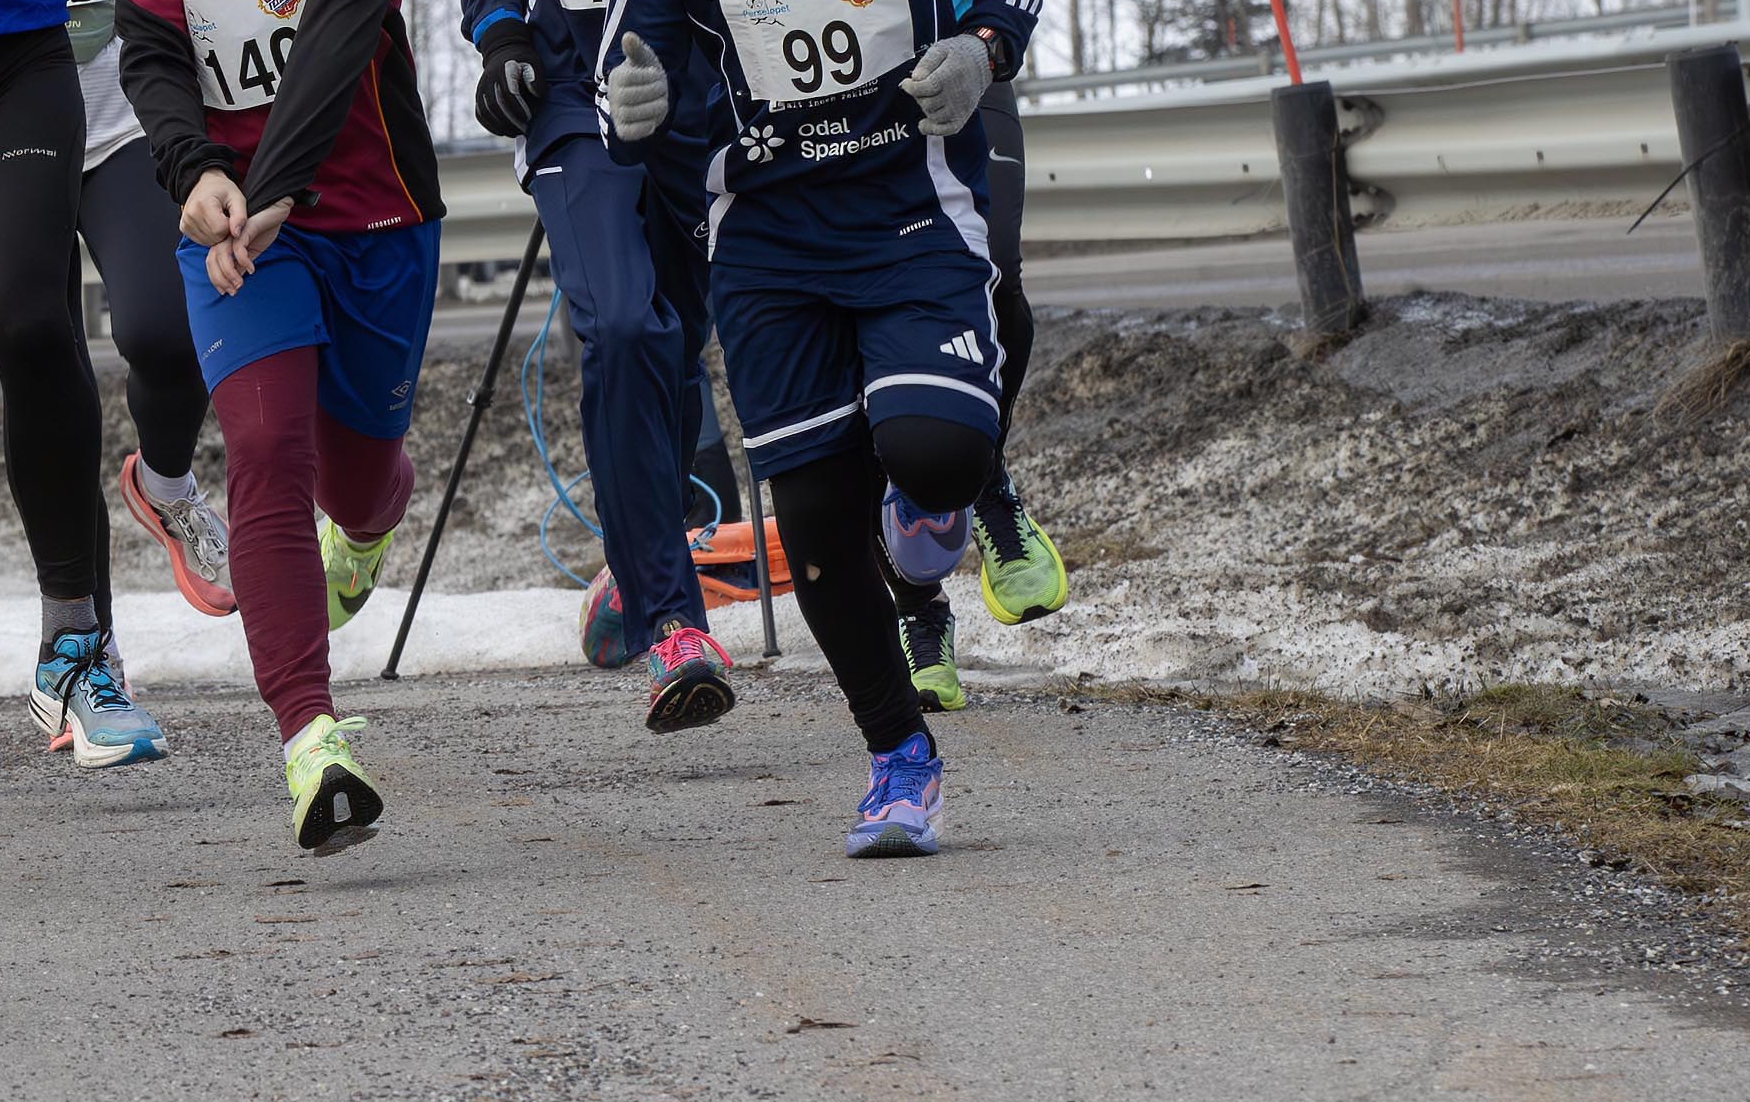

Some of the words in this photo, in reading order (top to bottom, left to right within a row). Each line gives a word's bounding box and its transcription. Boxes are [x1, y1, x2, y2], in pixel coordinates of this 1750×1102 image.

[782, 20, 863, 94] 99
[798, 117, 850, 137] Odal
[800, 121, 911, 162] Sparebank
